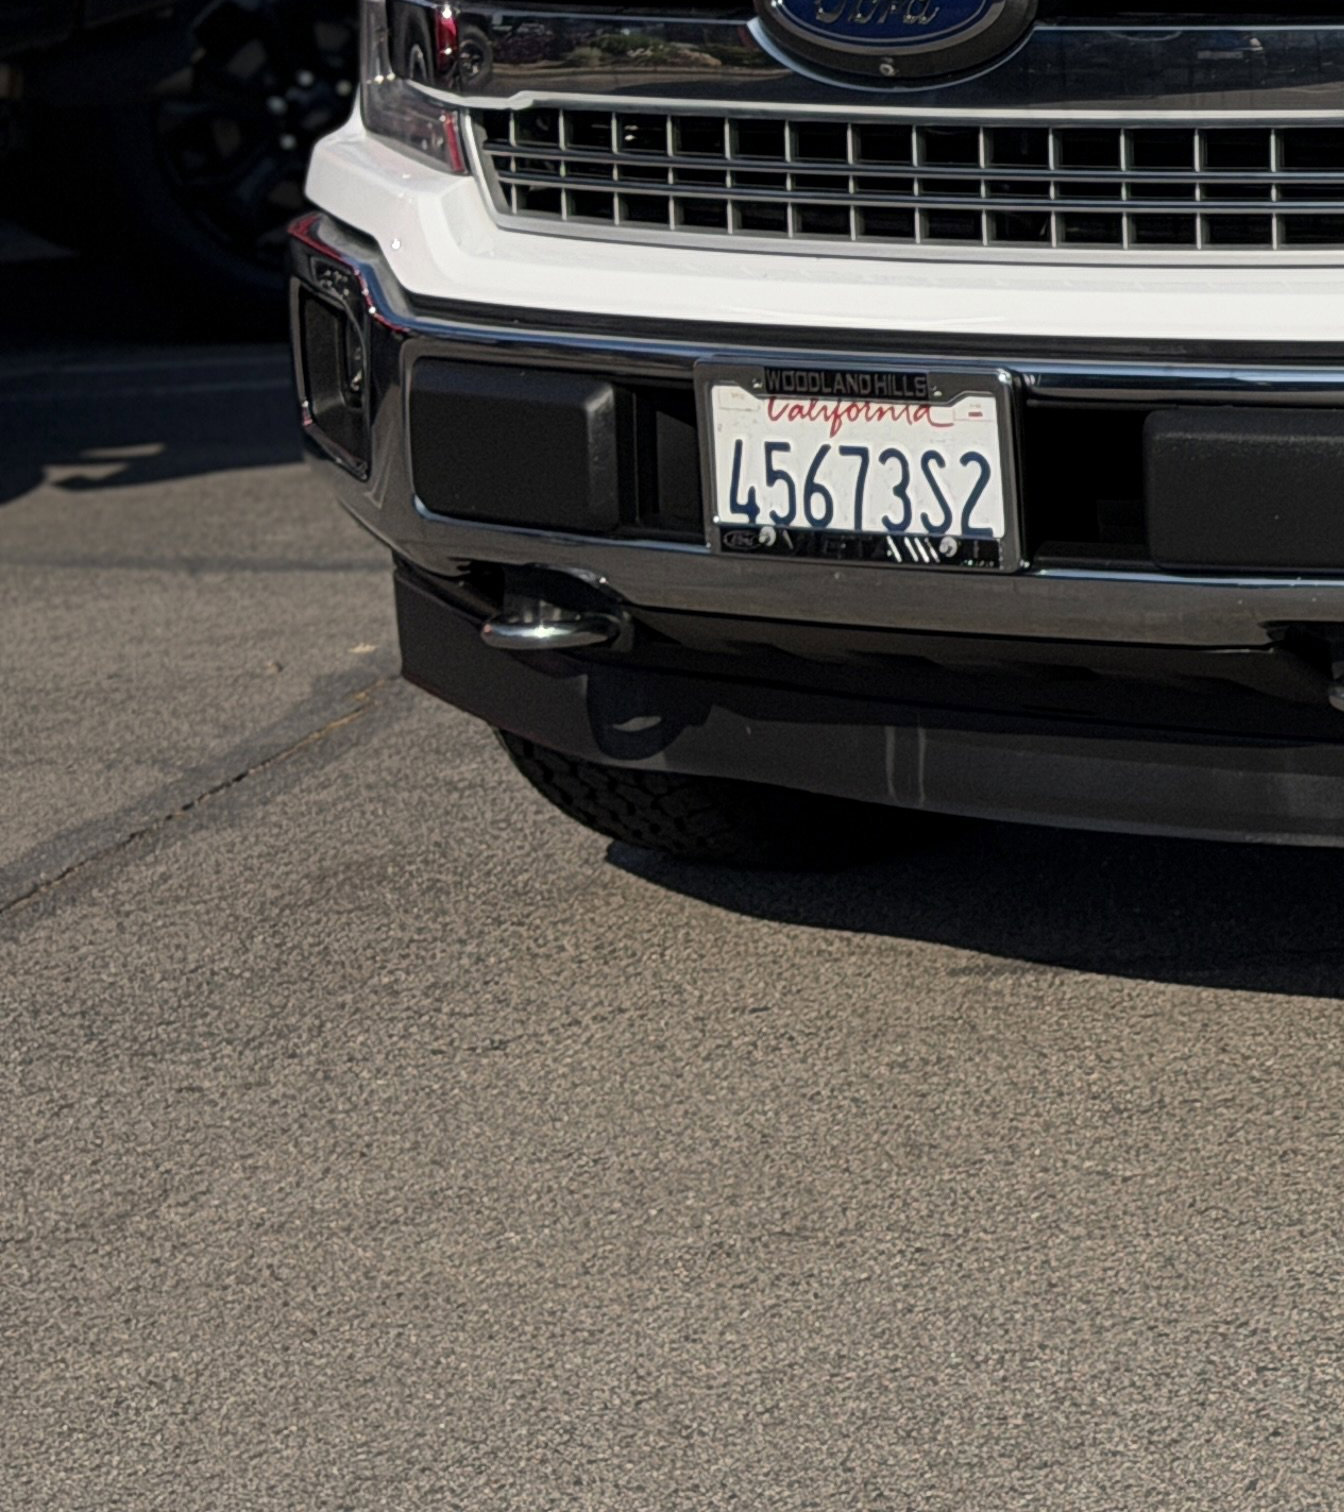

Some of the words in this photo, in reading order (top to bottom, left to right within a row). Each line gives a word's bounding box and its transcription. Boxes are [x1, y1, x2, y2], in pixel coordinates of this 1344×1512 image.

[765, 369, 872, 394] WOODLAND
[873, 373, 928, 398] HILLS
[767, 396, 954, 438] California
[730, 439, 994, 538] 45673S2
